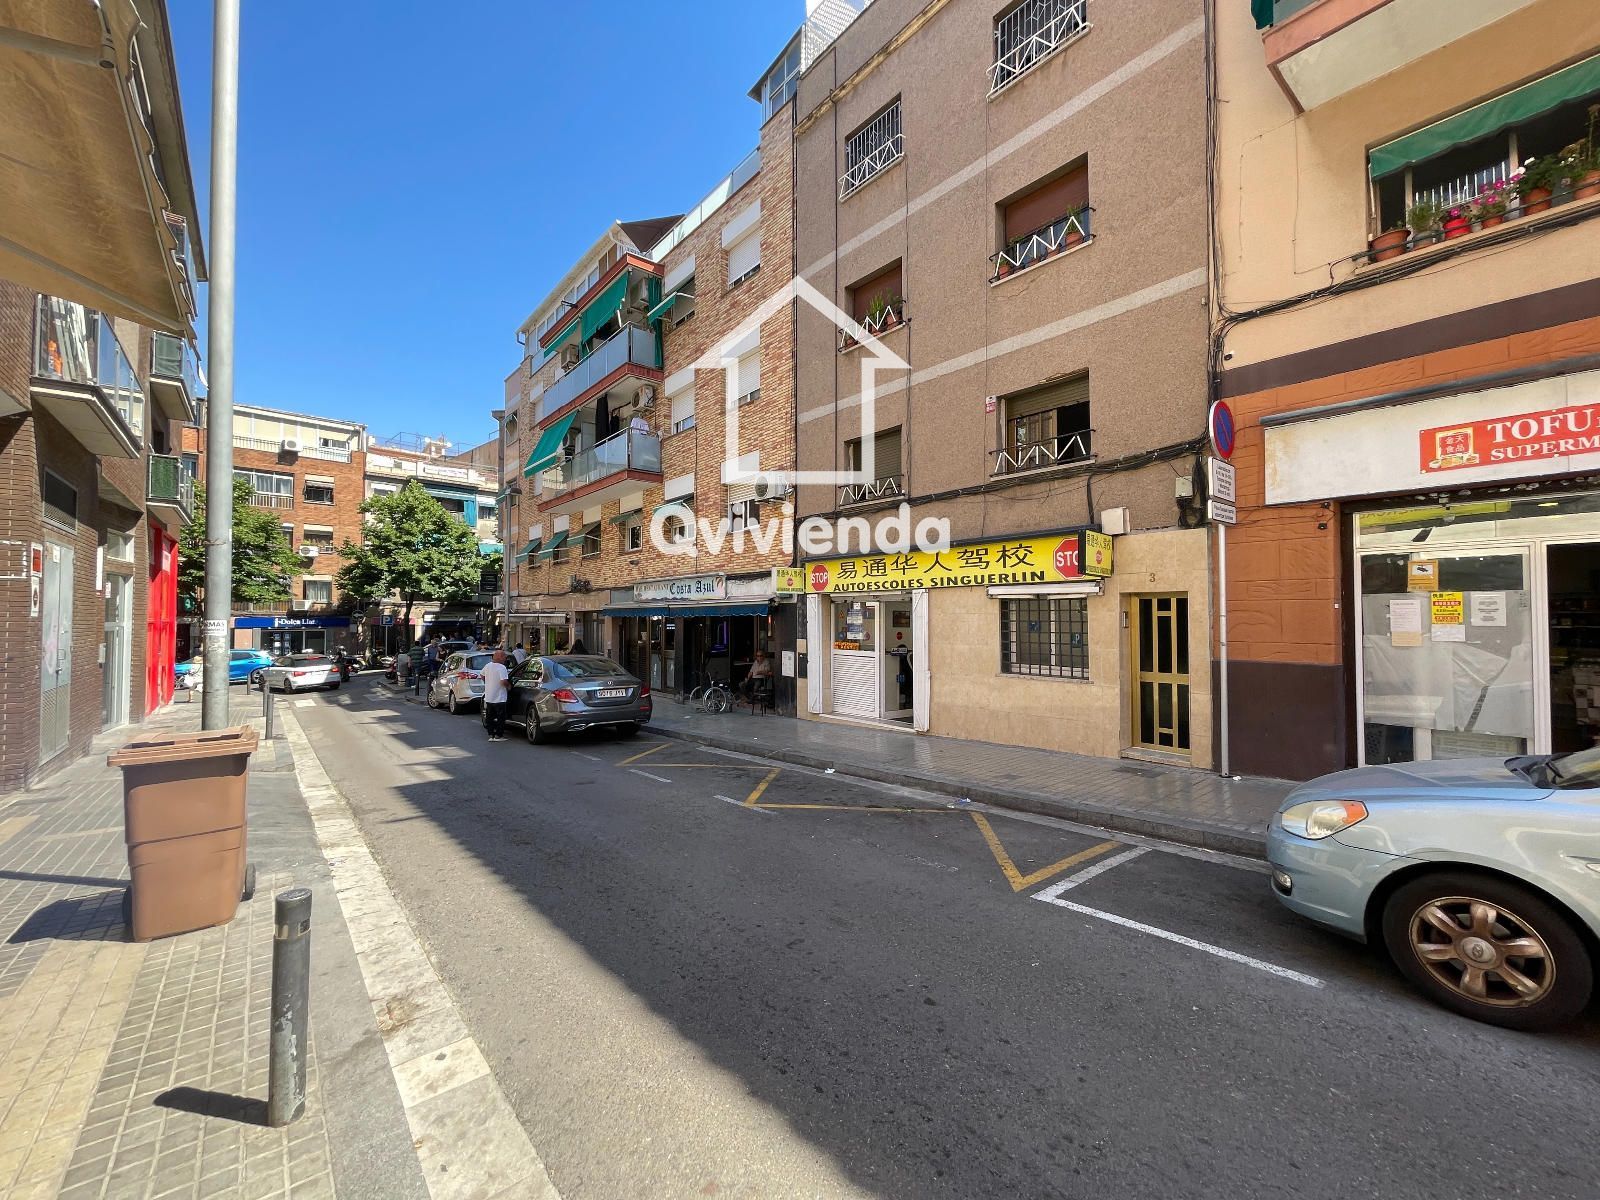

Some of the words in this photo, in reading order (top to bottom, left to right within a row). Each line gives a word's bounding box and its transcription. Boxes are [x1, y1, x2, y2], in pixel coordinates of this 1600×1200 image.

[1488, 408, 1595, 444] TOFU
[1490, 434, 1600, 461] SUPERM
[836, 543, 1035, 579] 易通华人驾校
[1056, 551, 1078, 567] STO
[811, 572, 828, 585] STOP
[833, 578, 923, 593] AUTOESCOLES
[930, 570, 1045, 587] SINGUERLIN
[1149, 573, 1156, 582] 3
[669, 582, 692, 595] Costa
[695, 579, 714, 595] Azul
[383, 616, 390, 625] P
